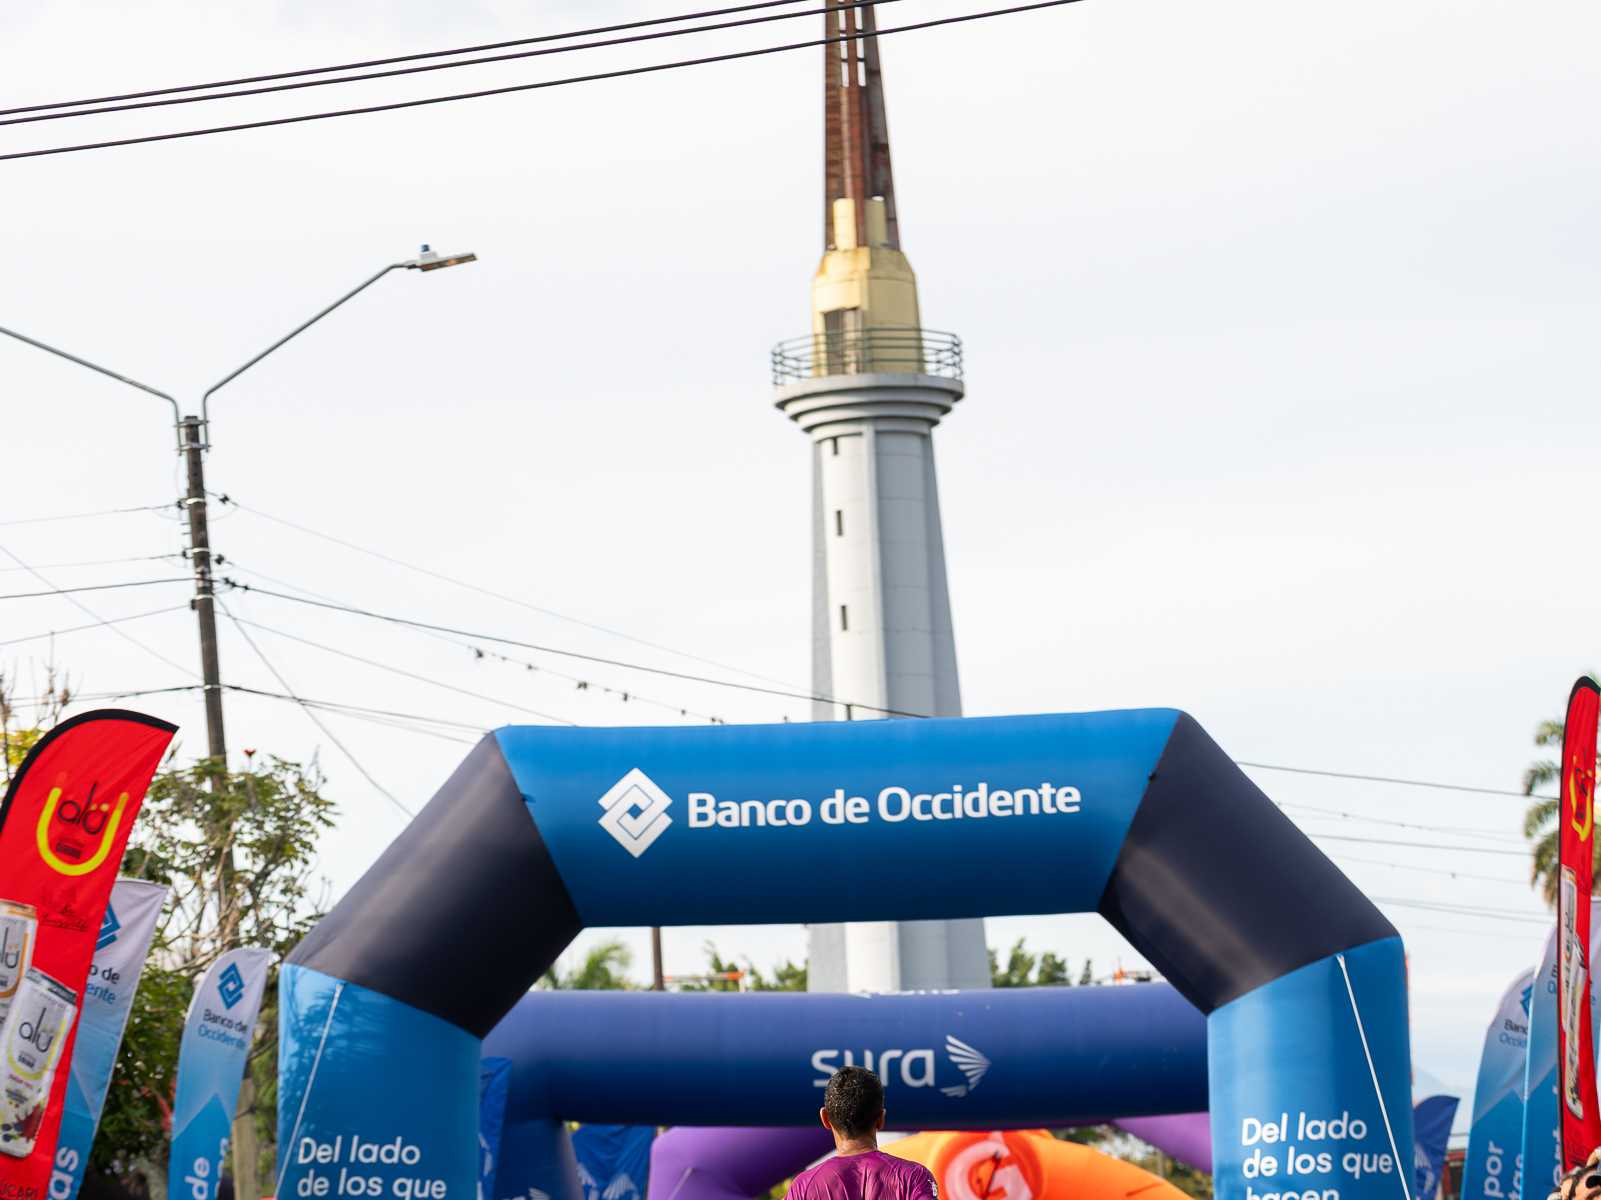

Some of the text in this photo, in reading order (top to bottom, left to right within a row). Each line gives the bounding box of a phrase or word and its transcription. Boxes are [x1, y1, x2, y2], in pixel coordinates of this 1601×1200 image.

[687, 782, 1082, 828] Banco de Occidente
[101, 967, 120, 985] de
[203, 1008, 234, 1029] Banco
[1241, 1110, 1367, 1146] Del lado
[297, 1134, 421, 1165] Del lado
[1243, 1145, 1393, 1180] de los que
[297, 1168, 330, 1198] de
[337, 1167, 383, 1197] los
[1484, 1140, 1504, 1198] por
